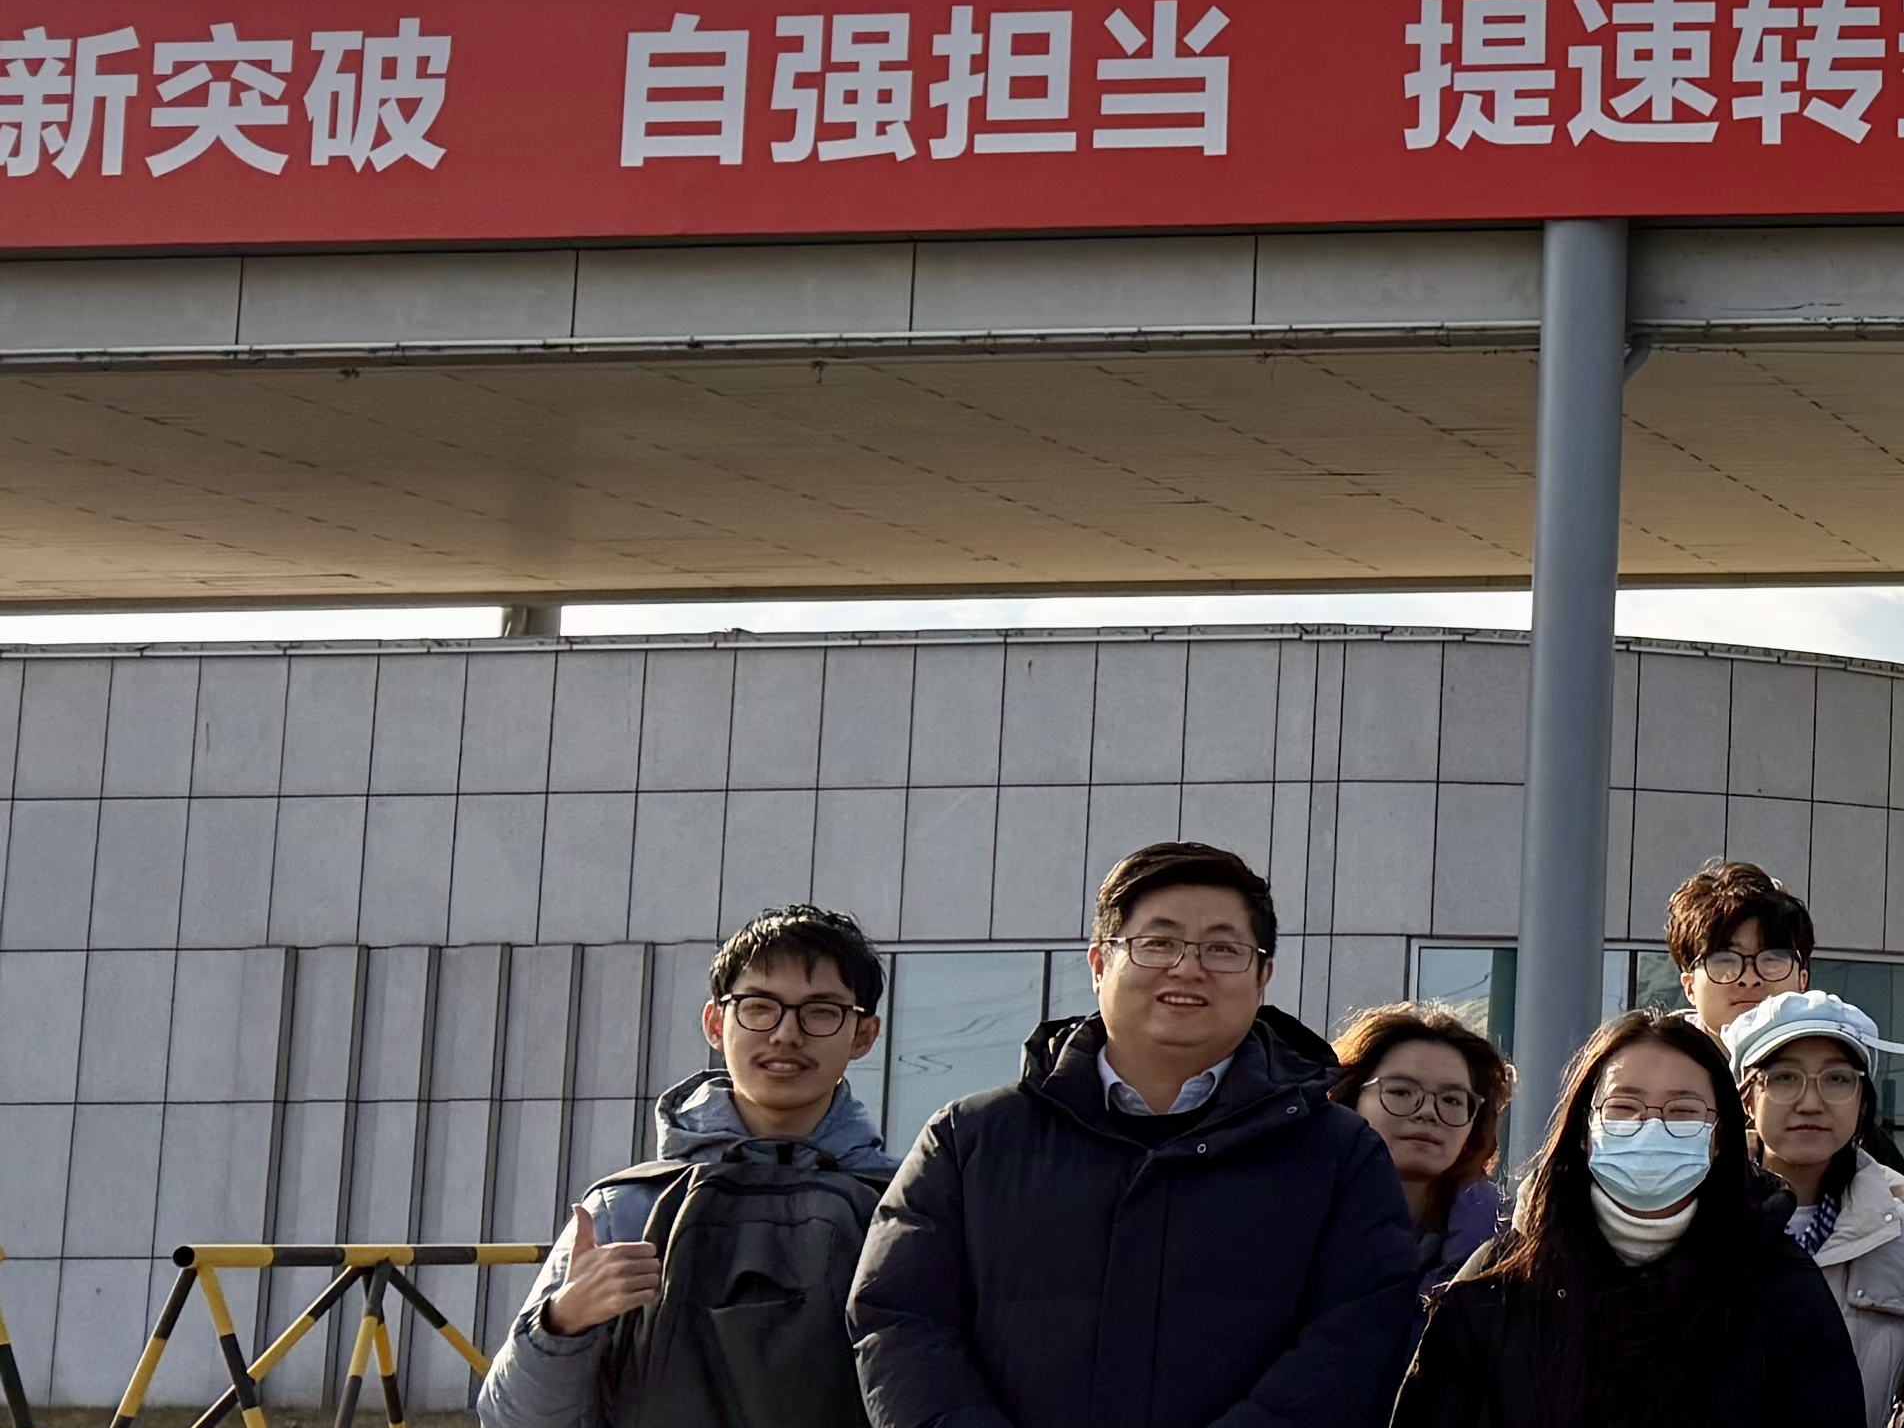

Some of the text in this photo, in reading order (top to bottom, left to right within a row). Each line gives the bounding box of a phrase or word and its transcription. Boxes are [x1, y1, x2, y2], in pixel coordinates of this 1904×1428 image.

[0, 17, 453, 179] 新突破
[620, 0, 1231, 167] 自强担当
